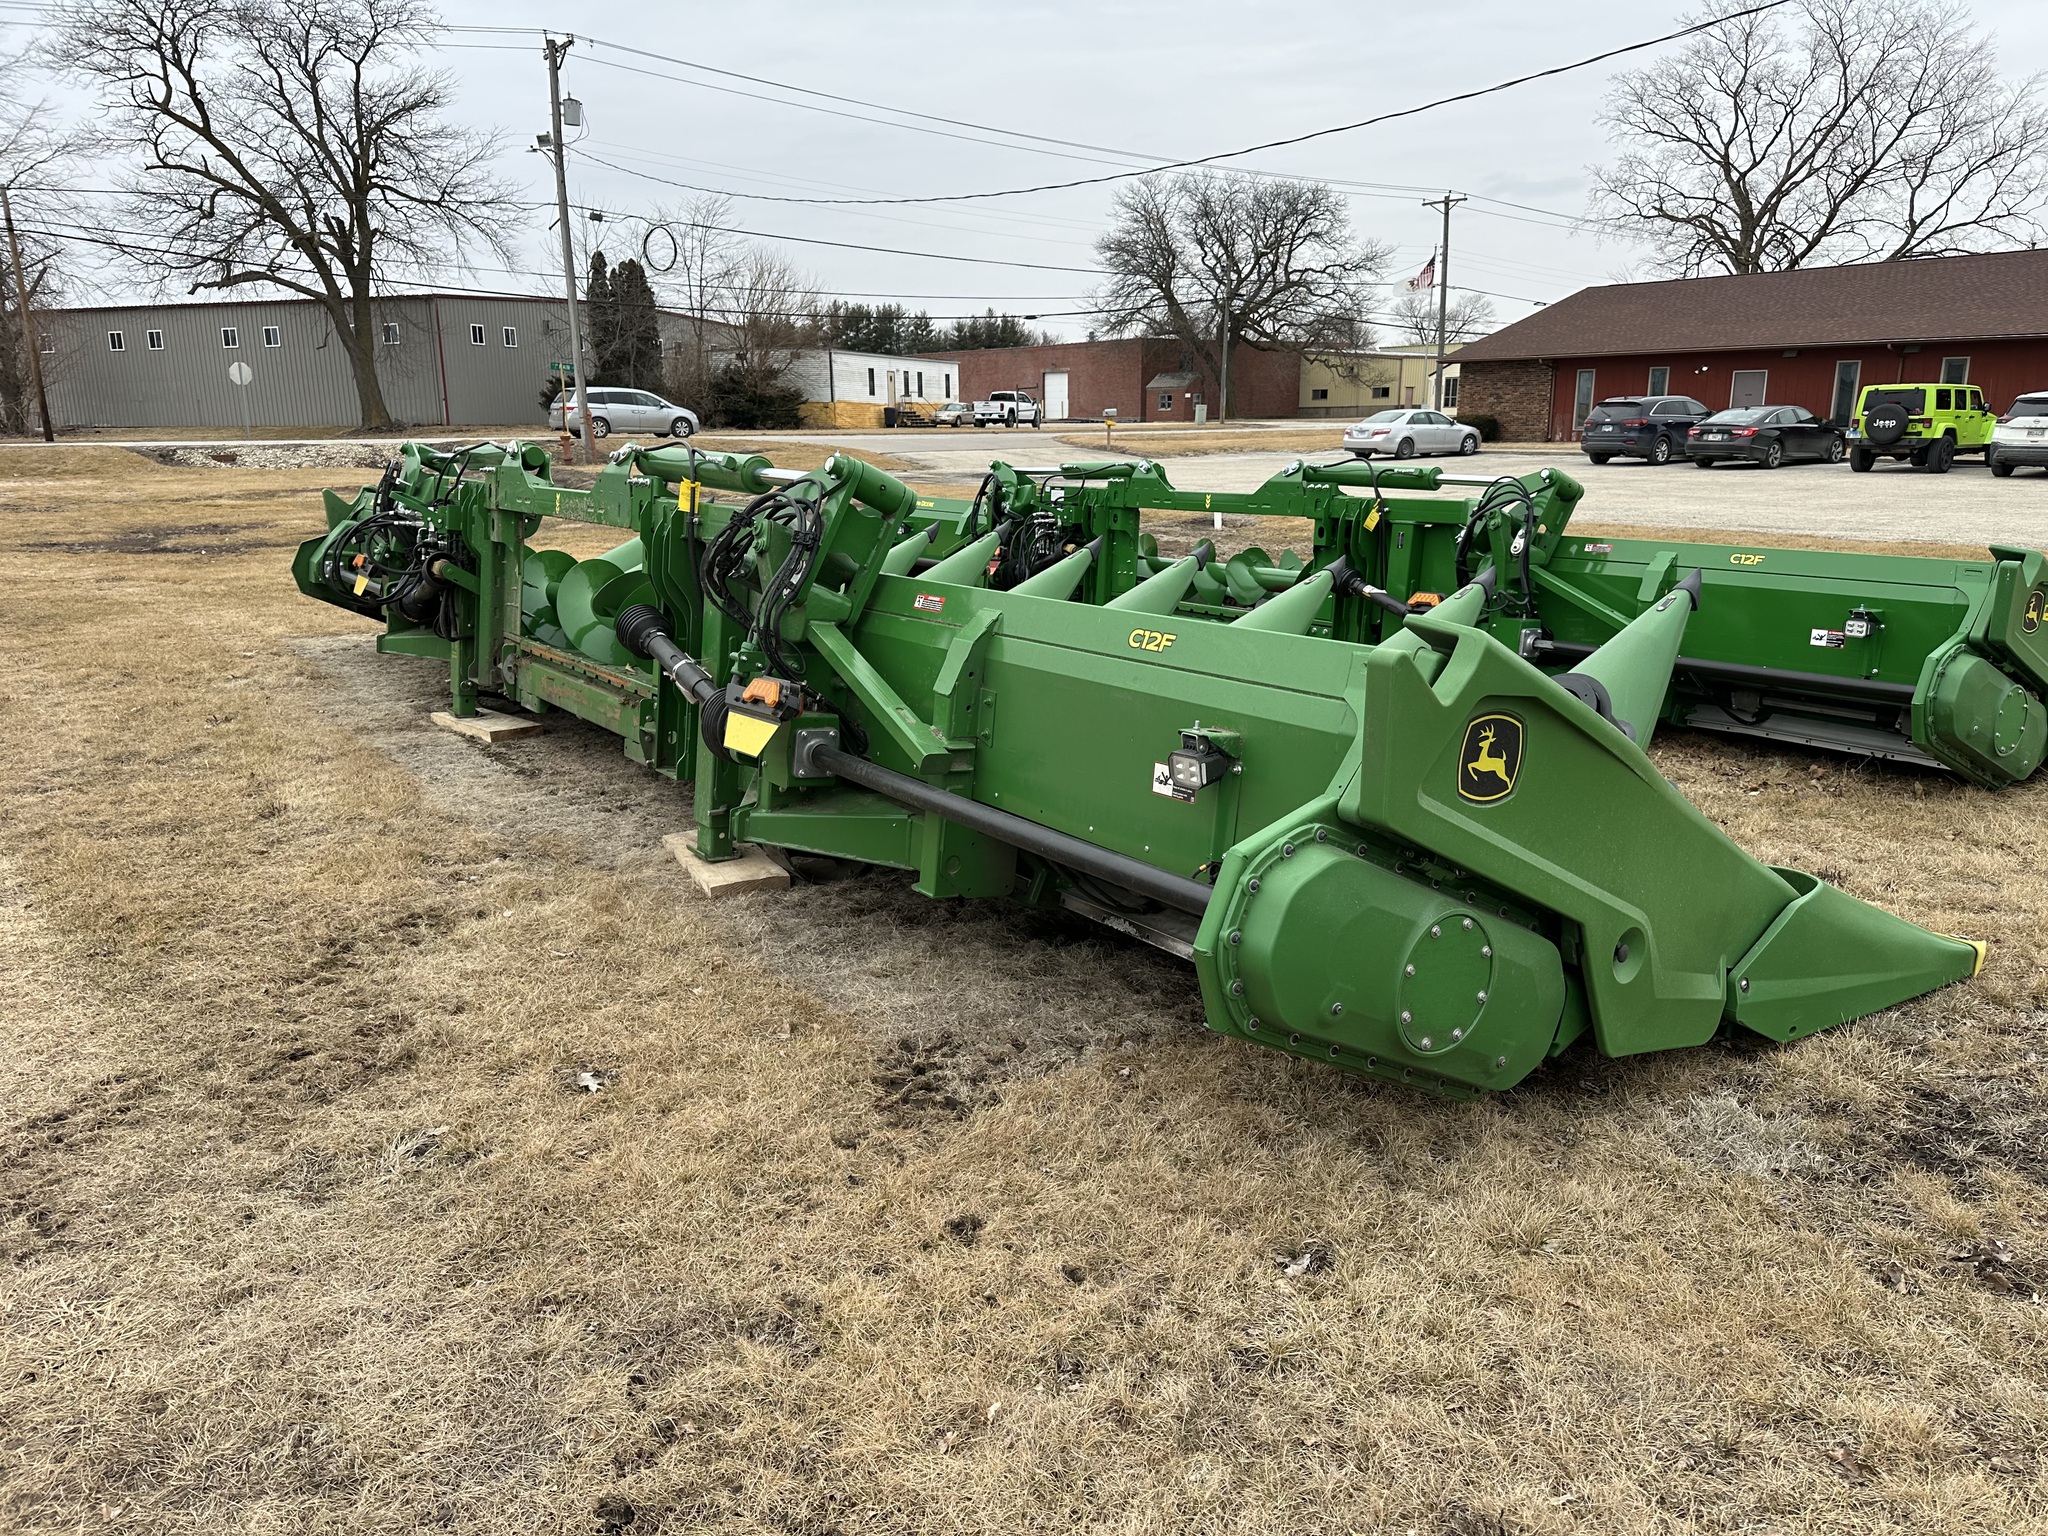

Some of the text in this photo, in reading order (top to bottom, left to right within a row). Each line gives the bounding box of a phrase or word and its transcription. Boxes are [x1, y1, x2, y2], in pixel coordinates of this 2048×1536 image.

[1873, 418, 1896, 428] Jeep
[1730, 553, 1766, 566] C12F
[1128, 628, 1177, 653] C12F
